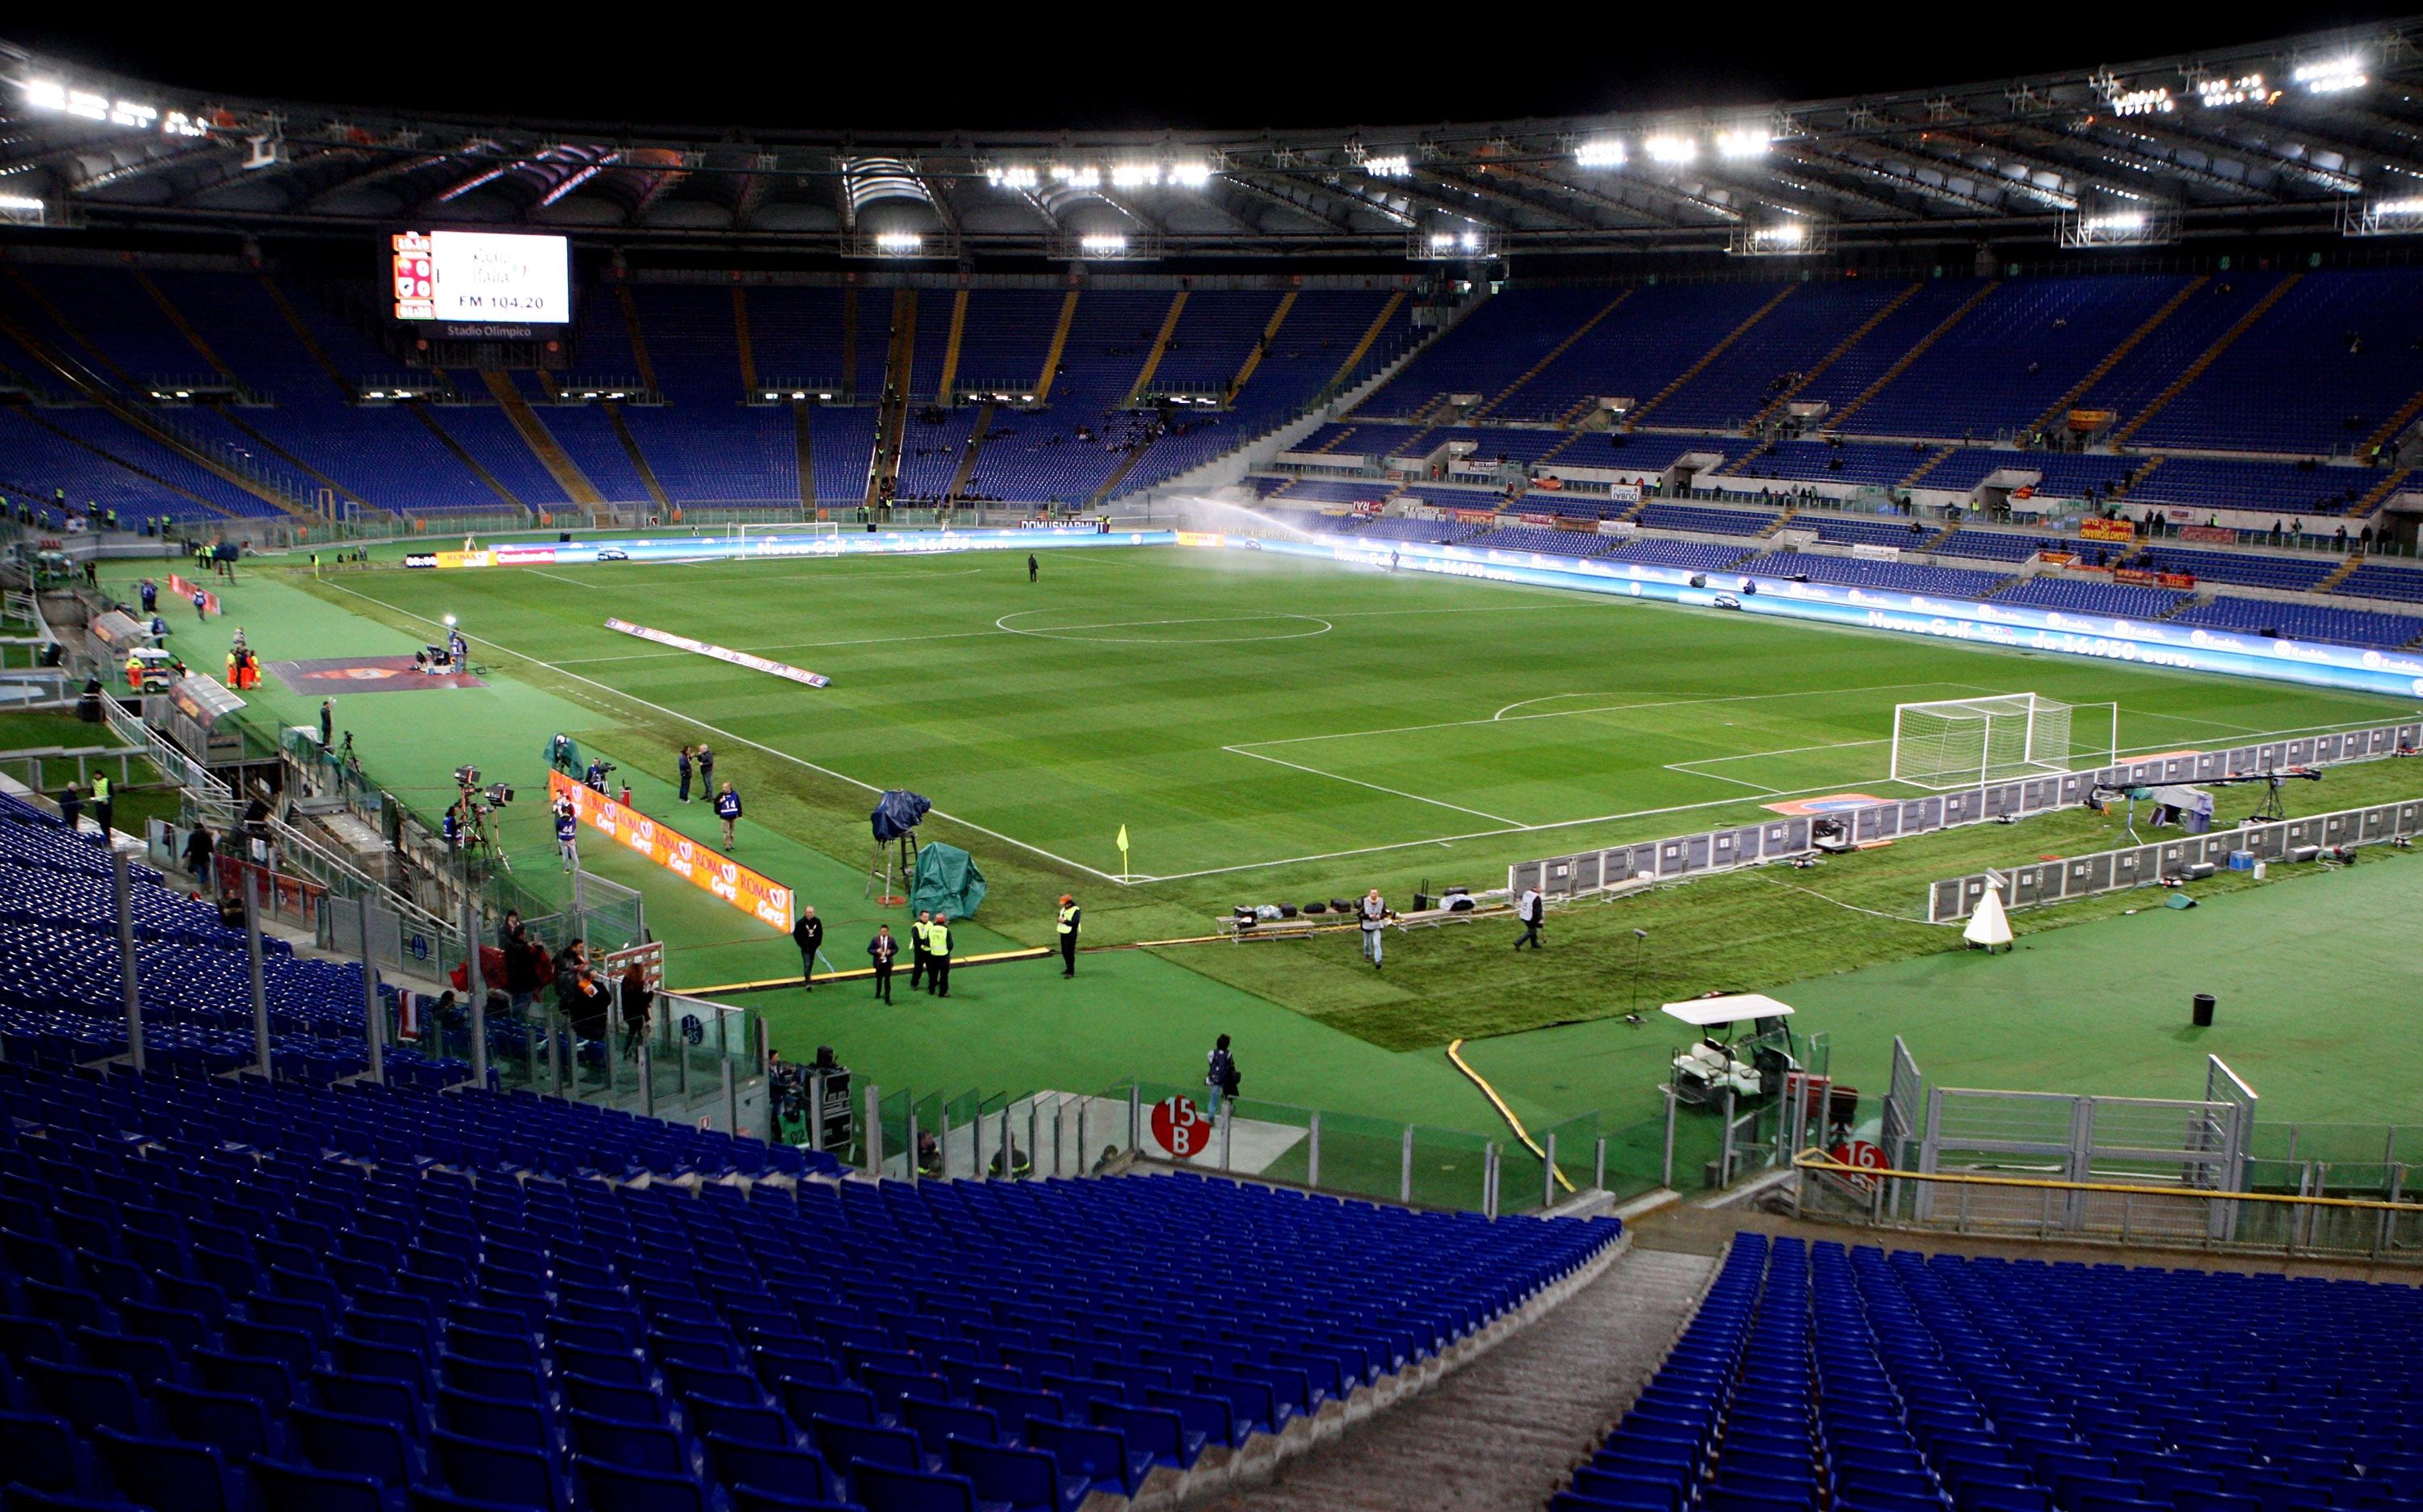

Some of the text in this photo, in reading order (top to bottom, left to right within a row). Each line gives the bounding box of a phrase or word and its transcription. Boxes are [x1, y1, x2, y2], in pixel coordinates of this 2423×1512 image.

[459, 296, 544, 309] FM 104.20
[447, 326, 531, 338] Stadio Olimpico
[757, 539, 846, 556] Nuova Golf
[894, 538, 914, 552] da
[918, 537, 969, 551] 16.950
[1868, 611, 1972, 638] Nuova Golf
[2030, 631, 2196, 669] da 16.950 euro.
[725, 800, 736, 809] 14
[631, 831, 653, 855] Cares
[655, 831, 681, 855] ROMA
[669, 853, 694, 877] Cares
[695, 853, 723, 878] ROMA
[711, 876, 737, 901] Cares
[741, 874, 771, 903] ROMA
[757, 900, 786, 926] Cares
[1165, 1097, 1195, 1127] 15
[1173, 1126, 1190, 1154] B
[1845, 1141, 1875, 1168] 16
